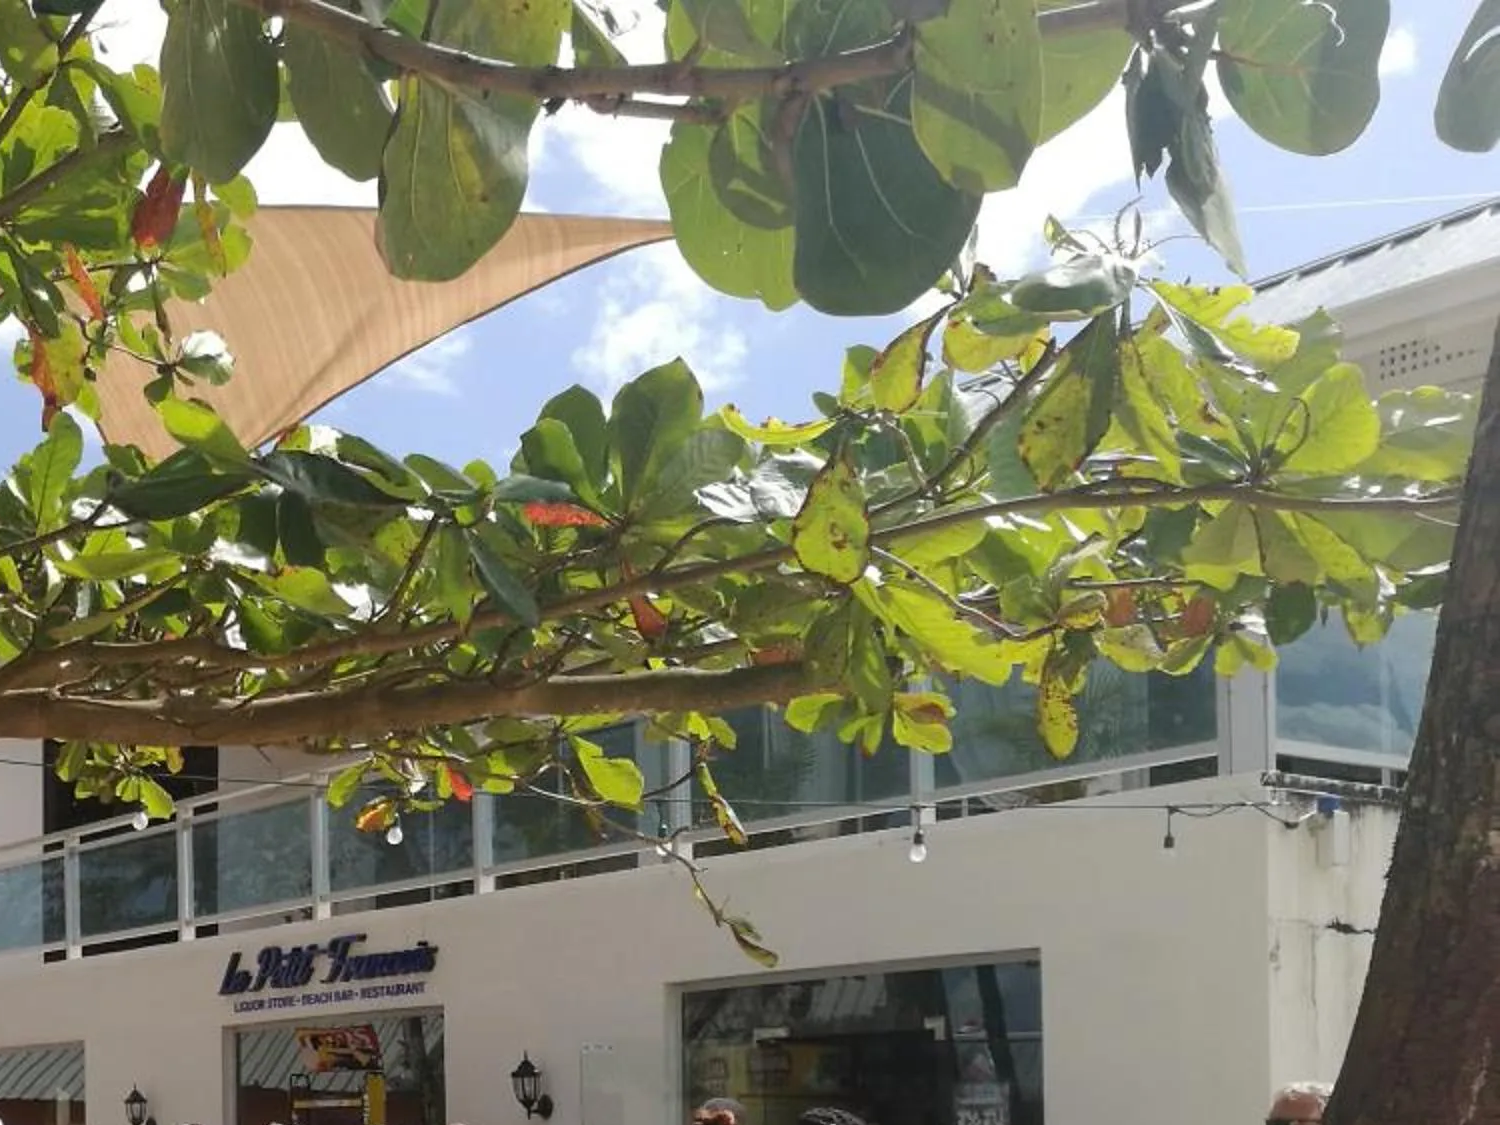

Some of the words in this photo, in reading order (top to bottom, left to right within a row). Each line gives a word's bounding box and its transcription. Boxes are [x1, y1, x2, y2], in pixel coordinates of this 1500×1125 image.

[234, 999, 264, 1012] LIQUOR
[267, 995, 297, 1009] STORE
[301, 991, 333, 1005] BEACH
[334, 989, 354, 1002] BAR
[360, 981, 427, 999] RESTAURANT
